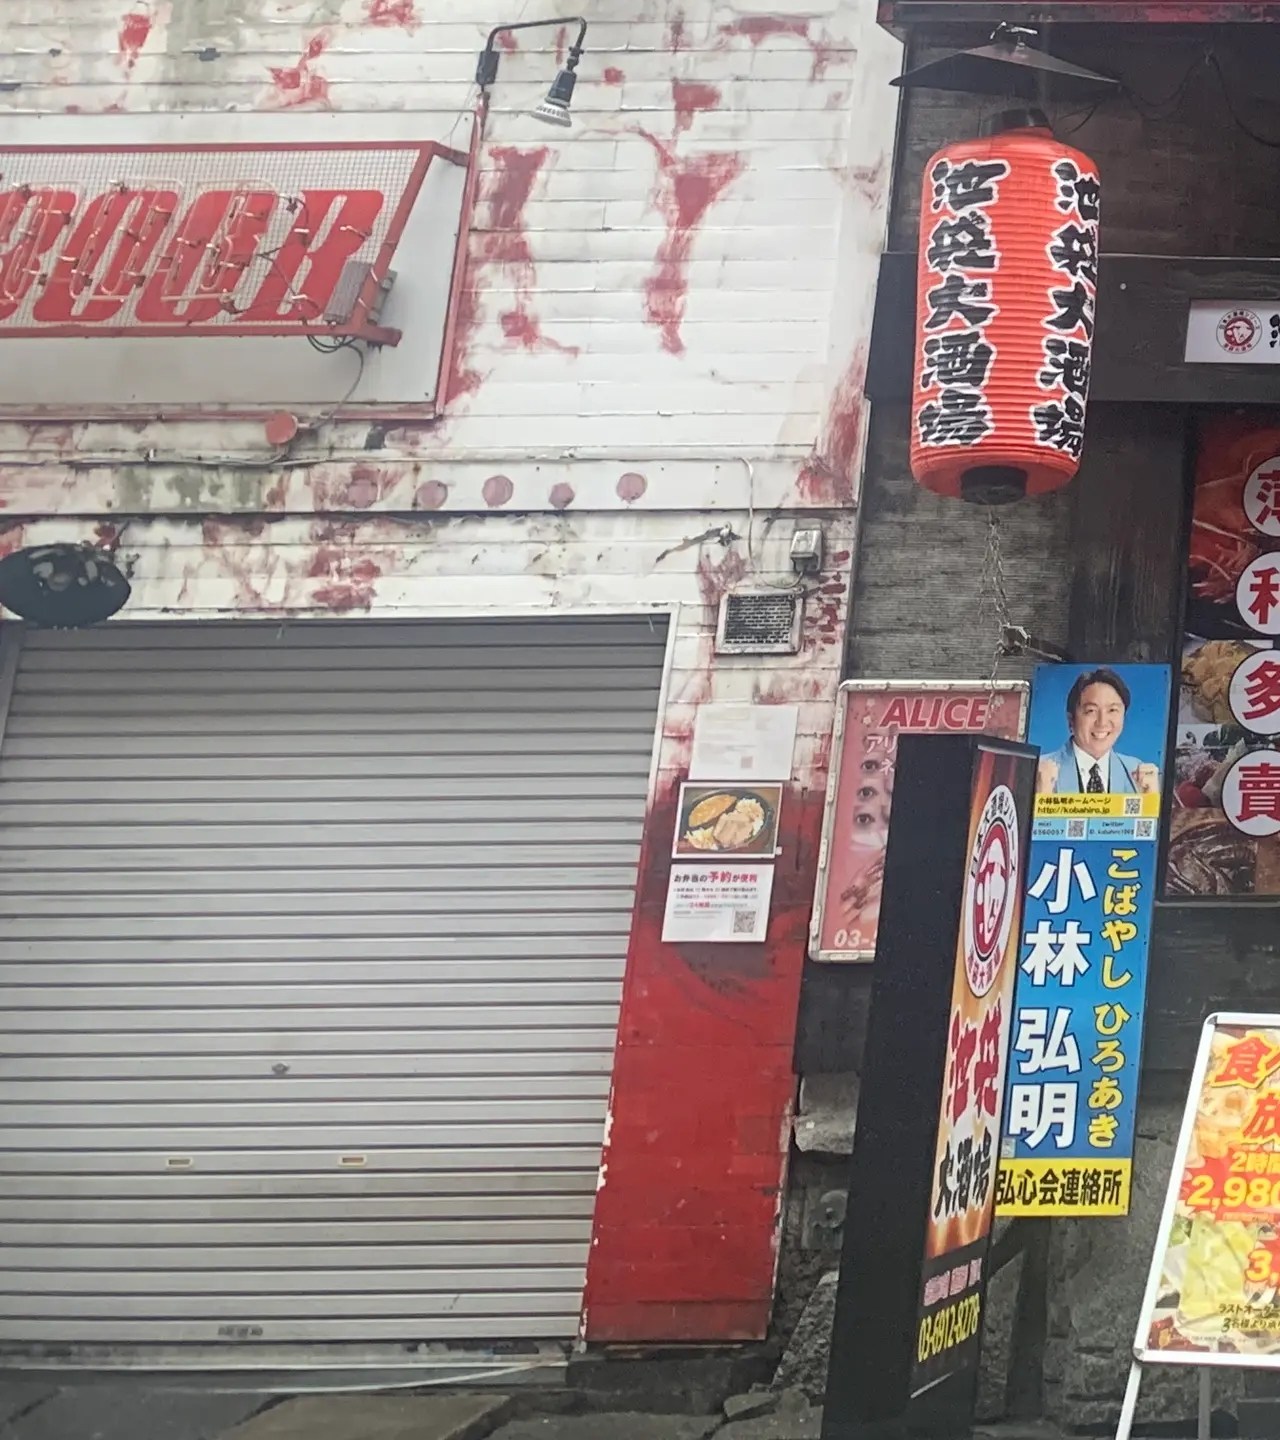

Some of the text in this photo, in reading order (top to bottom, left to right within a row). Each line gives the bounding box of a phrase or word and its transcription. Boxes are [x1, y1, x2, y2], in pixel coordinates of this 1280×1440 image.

[918, 157, 1010, 448] 池袋大酒場
[878, 697, 992, 728] ALICE
[946, 1000, 1003, 1126] 池袋
[933, 1127, 993, 1218] 大酒場
[996, 1167, 1123, 1207] 弘心会連絡所
